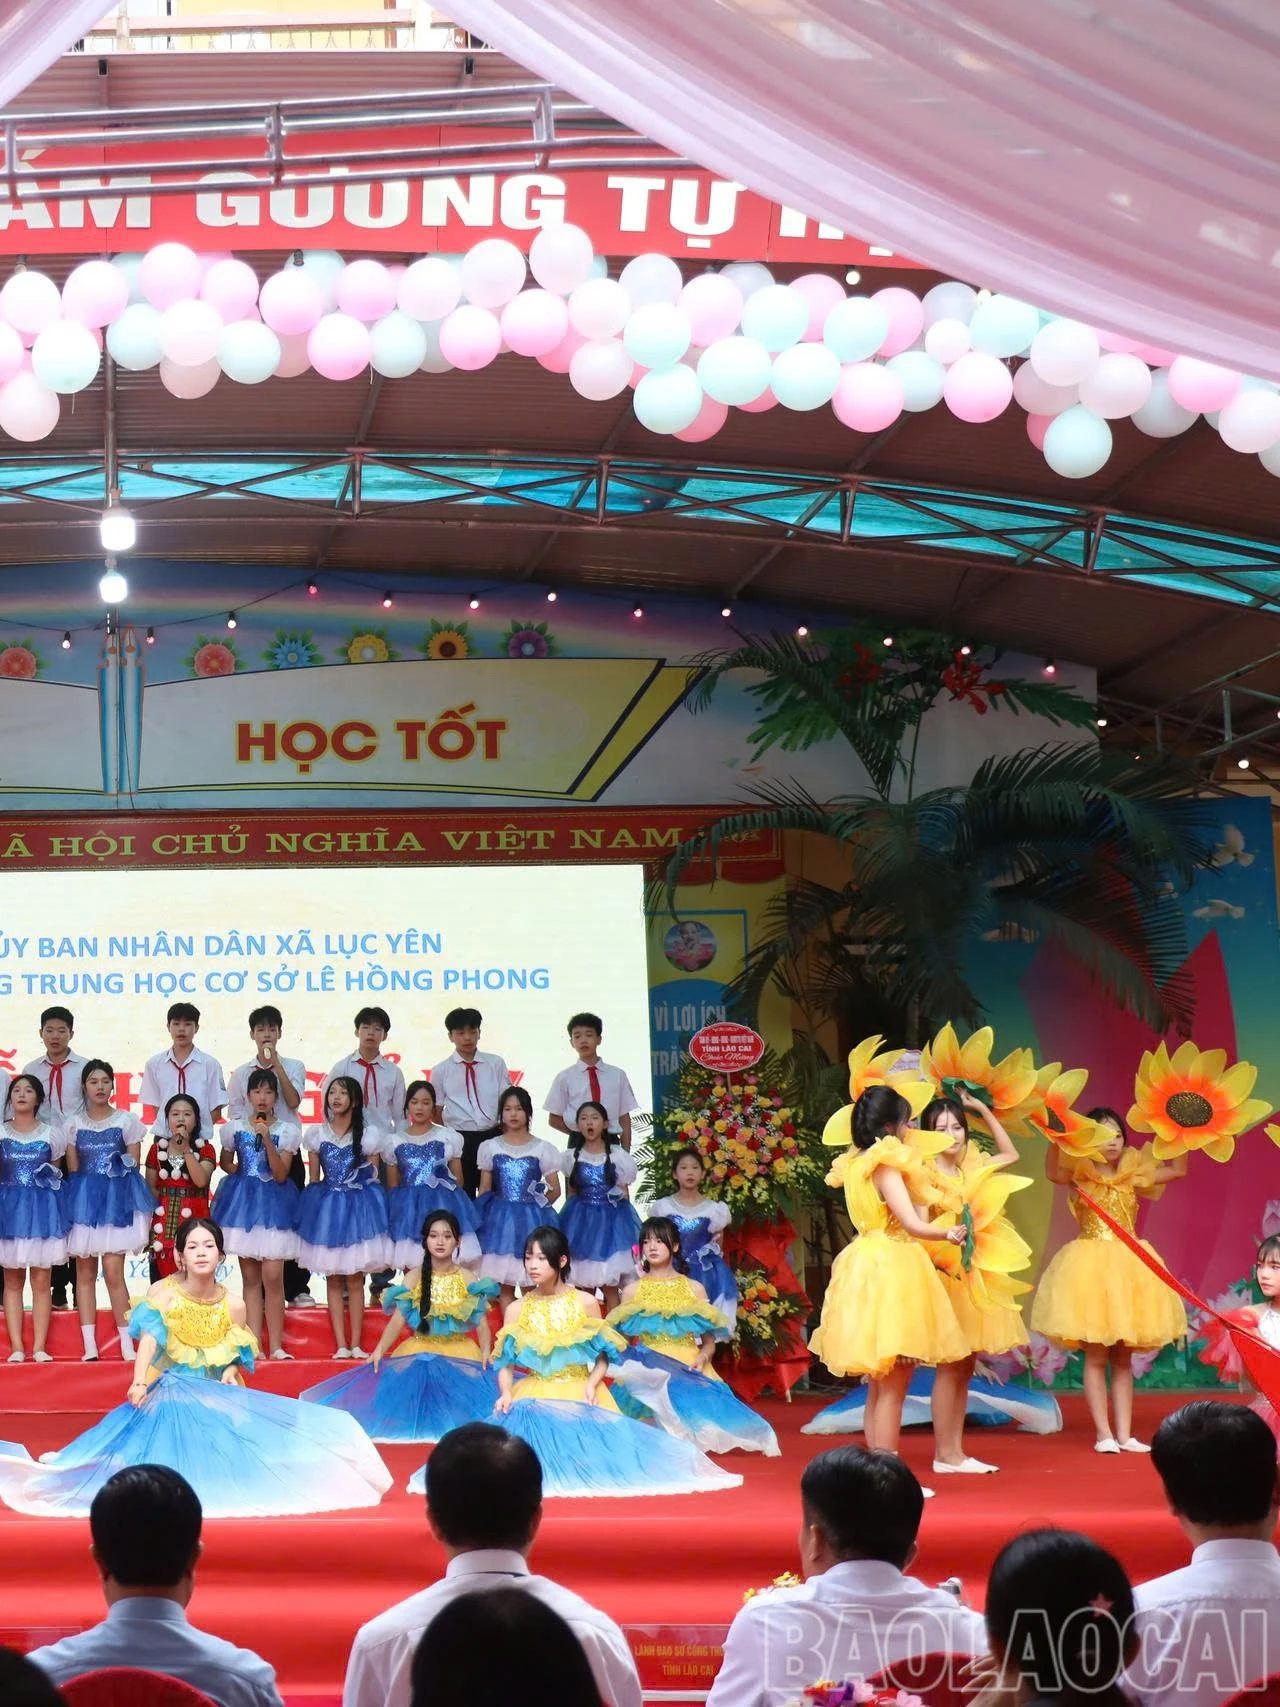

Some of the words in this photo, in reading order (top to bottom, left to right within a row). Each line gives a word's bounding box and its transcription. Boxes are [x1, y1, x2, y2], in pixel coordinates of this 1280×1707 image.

[237, 721, 378, 774] HỌC
[395, 703, 507, 760] TỐT
[49, 829, 137, 863] HỘI
[151, 824, 250, 855] CHỦ
[265, 828, 426, 853] NGHĨA
[440, 824, 557, 855] VIỆT
[569, 827, 687, 850] NAM
[38, 935, 98, 957] BAN
[109, 929, 197, 958] NHÂN
[204, 929, 268, 957] DÂN
[274, 928, 318, 956] XÃ
[324, 933, 378, 960] LỤC
[385, 927, 443, 954] YÊN
[21, 974, 127, 996] TRUNG
[133, 972, 197, 999] HỌC
[203, 970, 249, 994] CƠ
[255, 963, 301, 993] SỞ
[306, 963, 337, 993] LÊ
[344, 959, 437, 992] HỒNG
[443, 967, 551, 991] PHONG
[654, 1001, 668, 1032] VÌ
